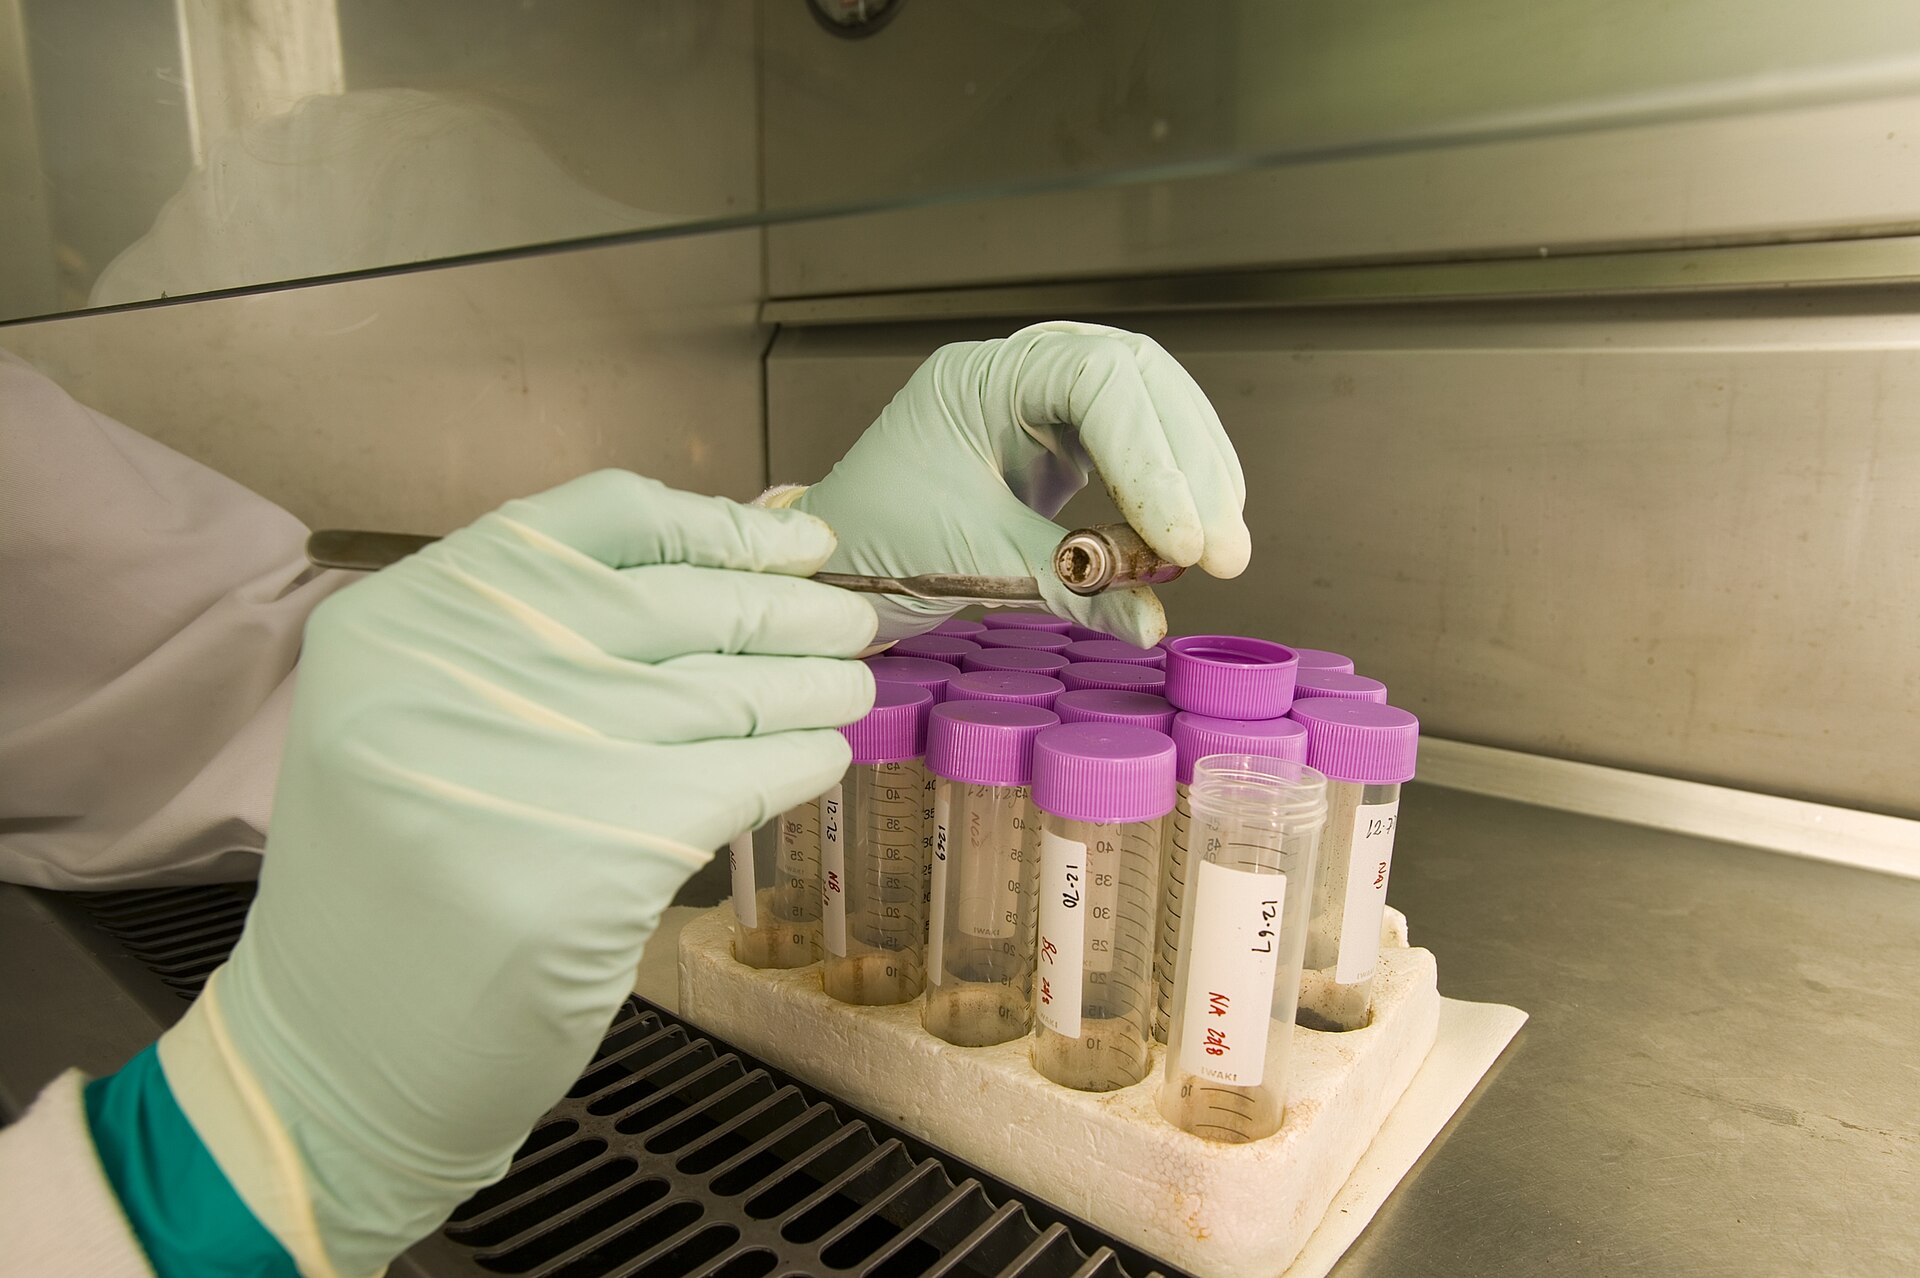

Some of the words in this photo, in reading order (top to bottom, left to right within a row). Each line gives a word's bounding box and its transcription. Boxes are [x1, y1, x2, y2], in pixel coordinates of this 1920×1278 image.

[828, 871, 841, 893] NB
[1208, 991, 1230, 1016] NA
[1201, 1066, 1237, 1081] IWAKI
